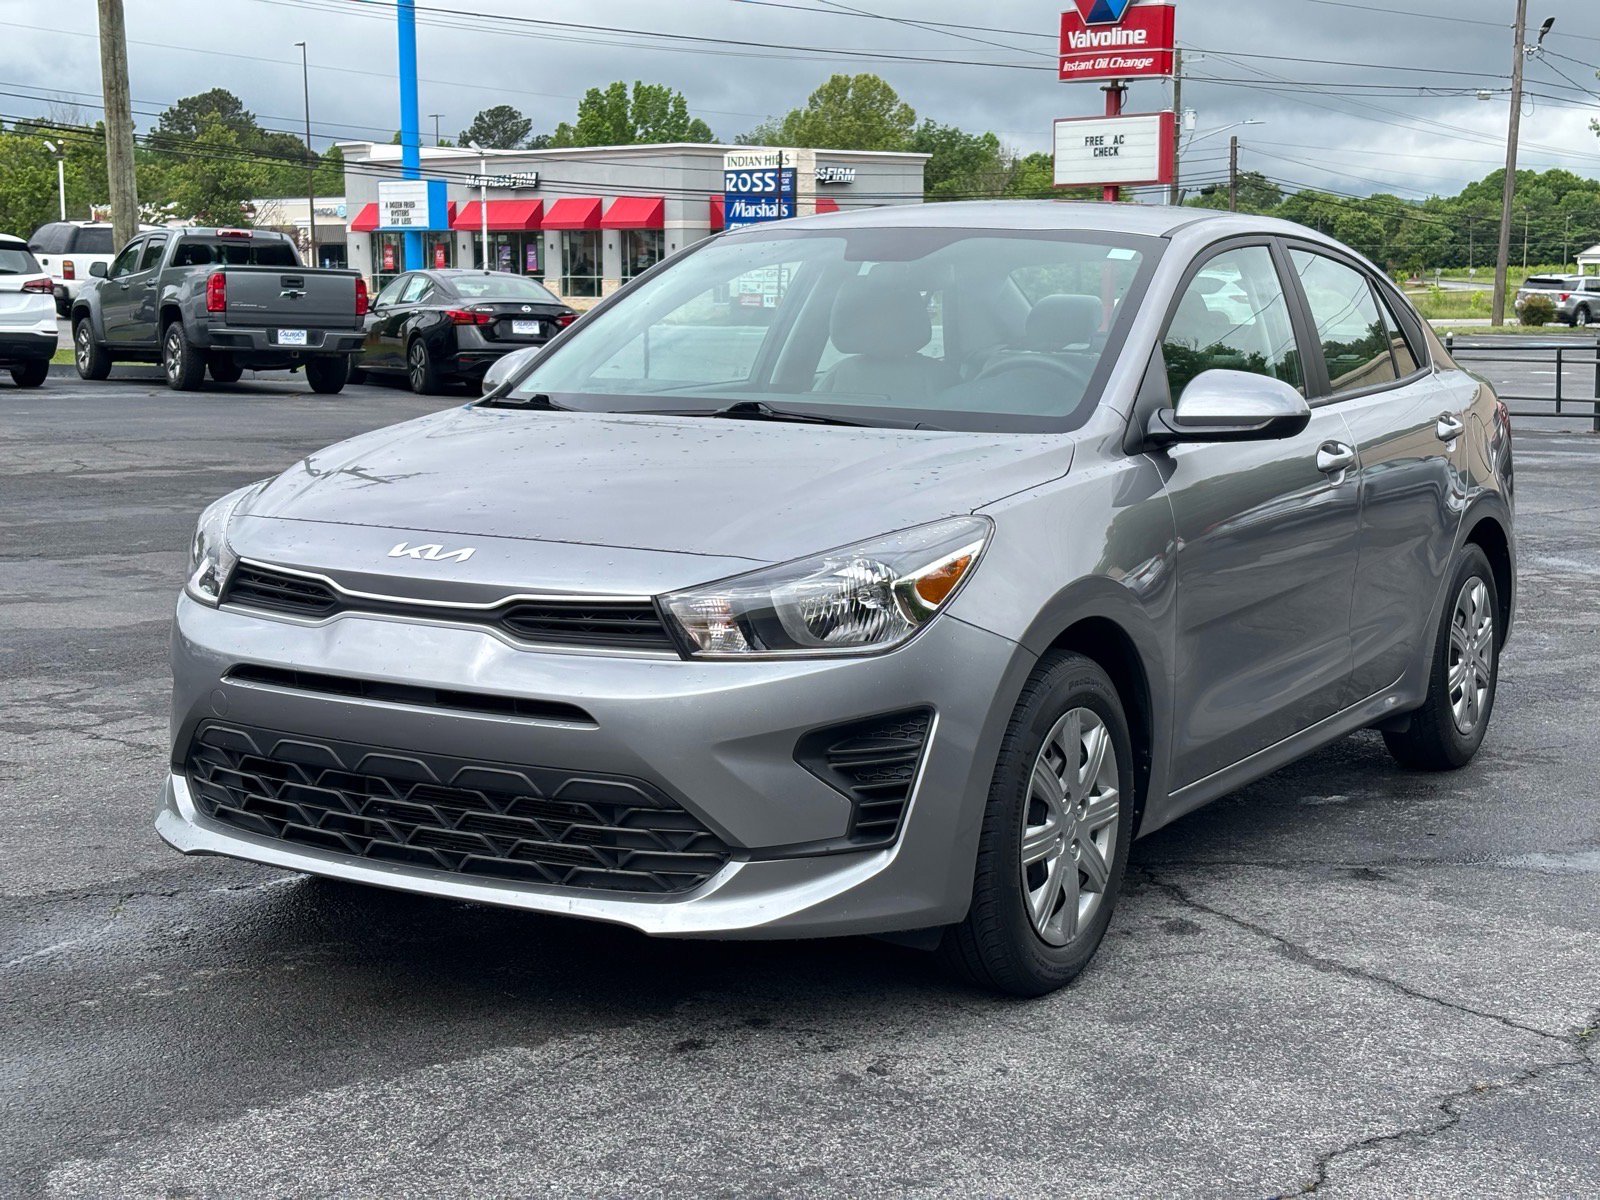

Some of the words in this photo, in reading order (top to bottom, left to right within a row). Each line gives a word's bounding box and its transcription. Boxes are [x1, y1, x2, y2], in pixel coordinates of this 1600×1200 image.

[1068, 27, 1147, 49] Valvoline
[1063, 60, 1093, 71] Instant
[1094, 57, 1108, 68] Oil
[1109, 57, 1153, 69] Change
[1085, 136, 1104, 146] FREE
[1113, 135, 1124, 145] AC
[1093, 146, 1119, 157] CHECK
[727, 155, 762, 167] INDIAN
[764, 153, 790, 166] HILS
[725, 173, 776, 192] ROSS
[729, 199, 789, 217] Marshalls
[388, 542, 477, 563] KIA
